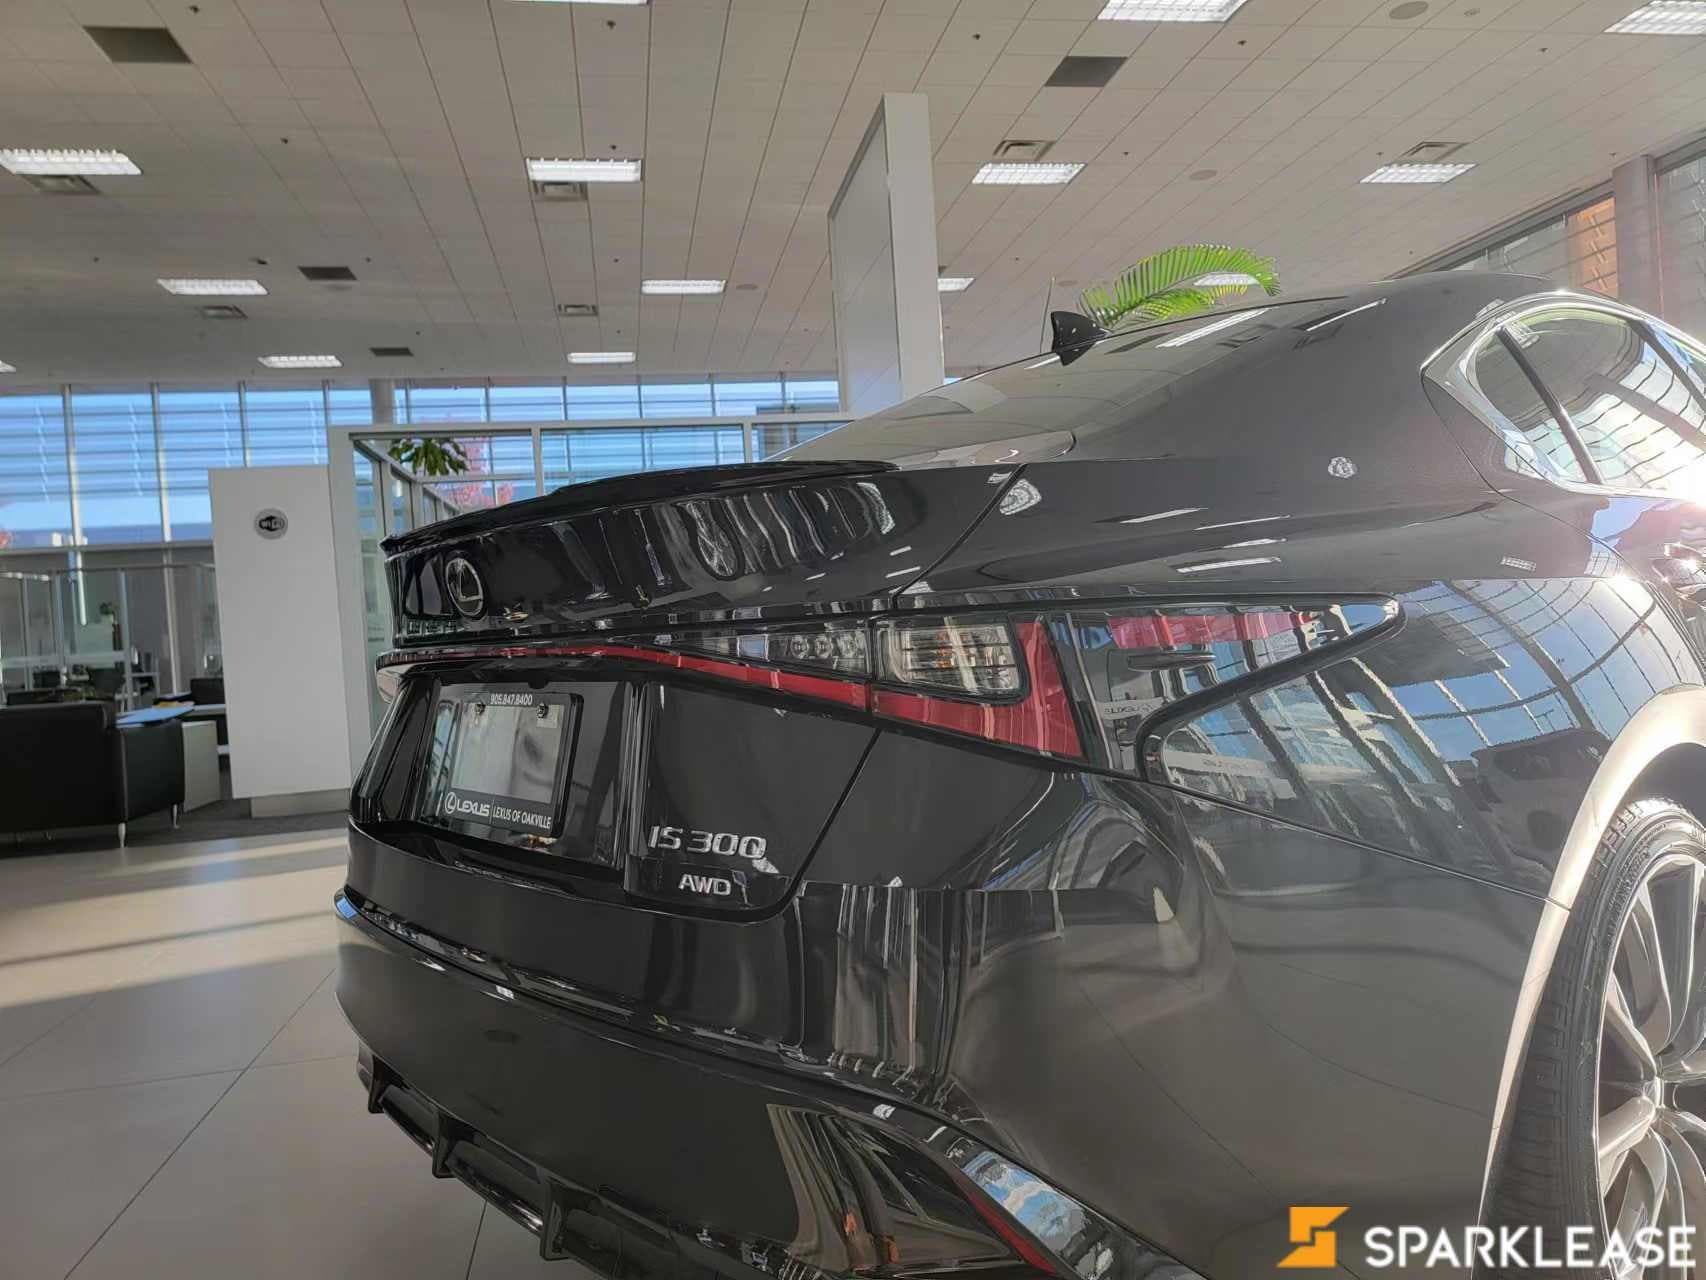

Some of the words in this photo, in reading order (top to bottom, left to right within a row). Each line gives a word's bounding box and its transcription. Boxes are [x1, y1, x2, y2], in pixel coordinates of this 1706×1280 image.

[457, 799, 490, 816] LEXUS
[493, 806, 511, 820] LEXUS
[512, 809, 521, 822] OF
[521, 811, 552, 829] OAKVILLE
[649, 825, 683, 849] IS
[687, 830, 767, 858] 300
[678, 873, 731, 895] AWD
